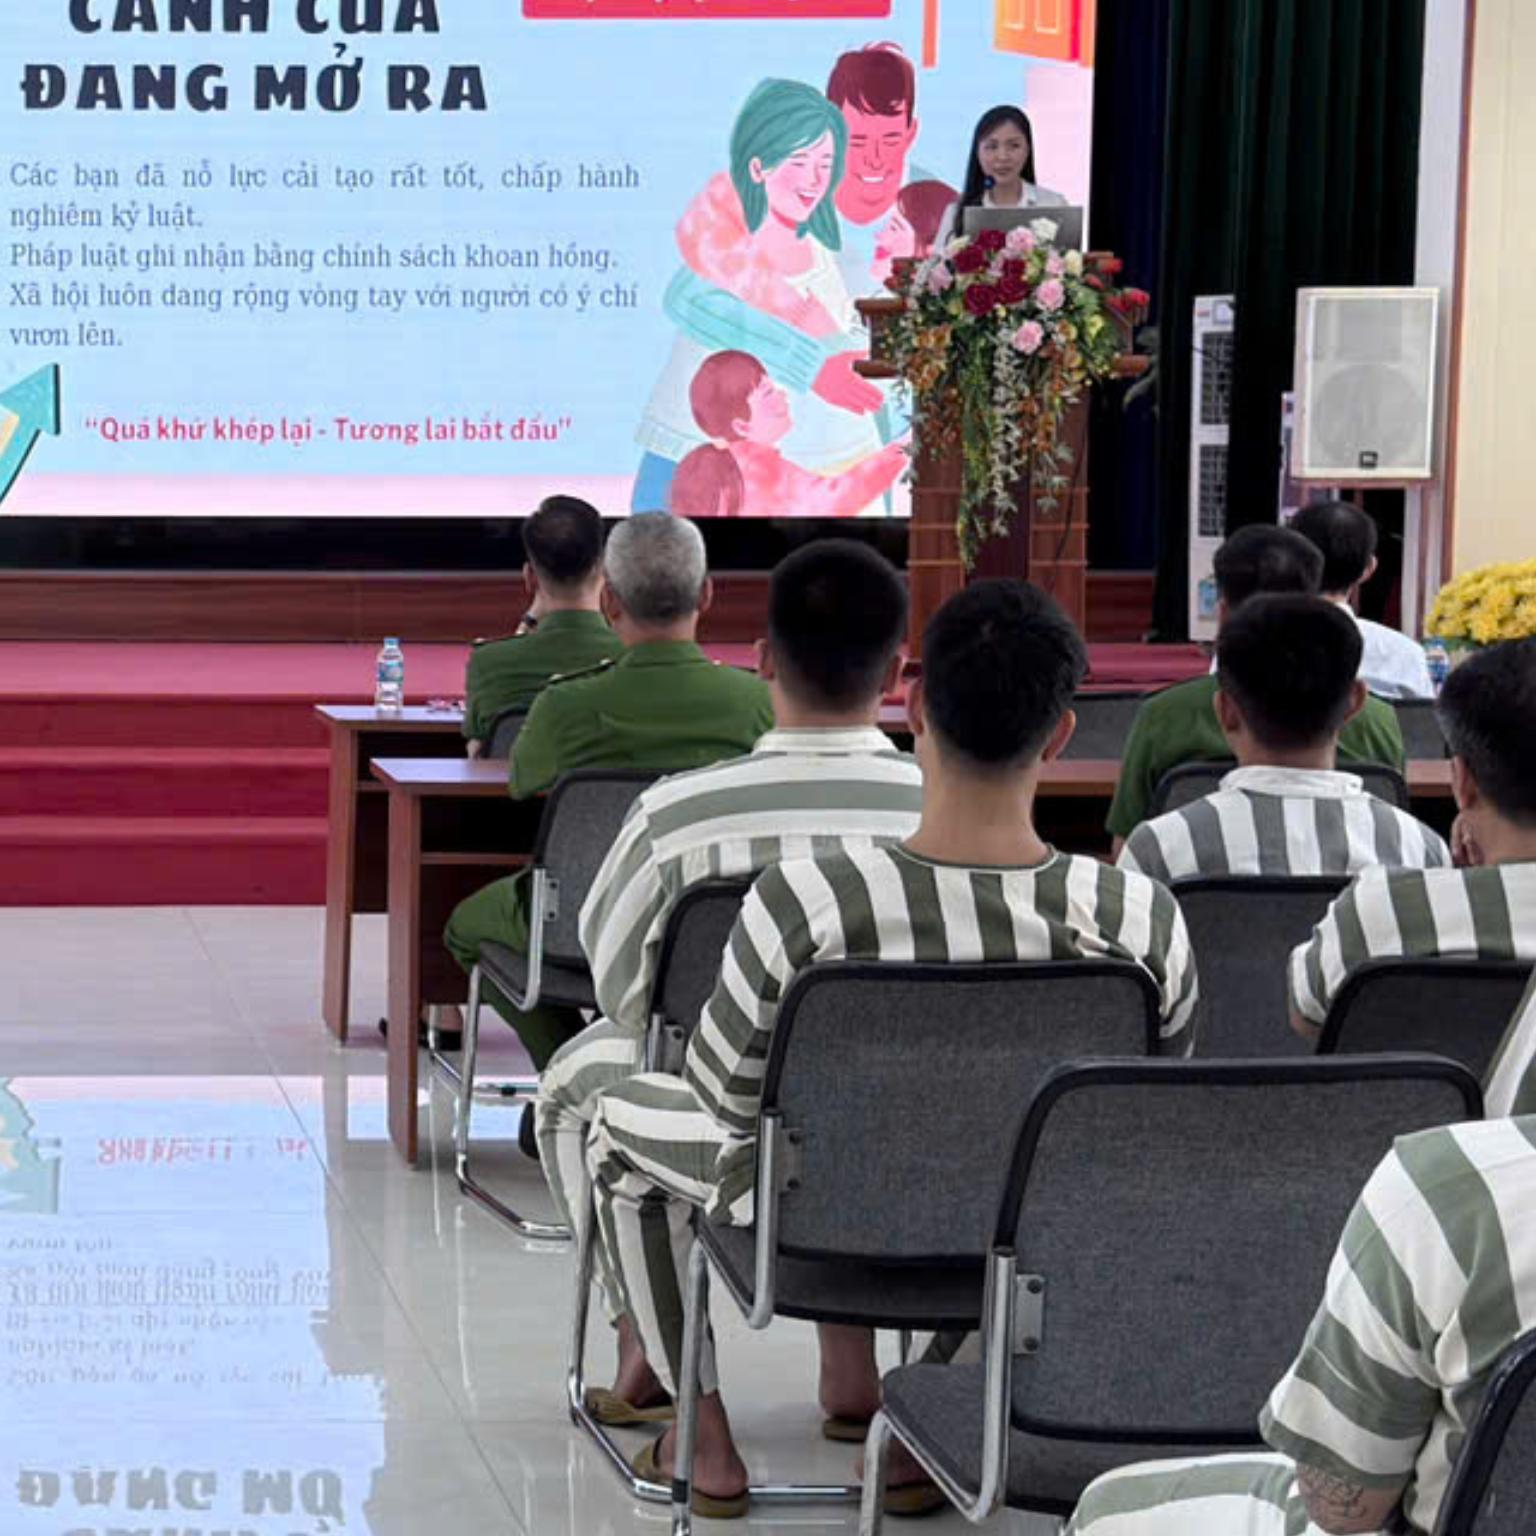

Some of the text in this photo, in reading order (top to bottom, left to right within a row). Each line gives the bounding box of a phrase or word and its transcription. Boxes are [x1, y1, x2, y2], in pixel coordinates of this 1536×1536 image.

[20, 43, 487, 112] ĐANG MỞ RA
[10, 159, 640, 192] Các bạn đã nỗ lực cải tạo rất tốt, chấp hành
[10, 202, 102, 231] nghiêm
[148, 202, 203, 231] luật.
[10, 242, 73, 271] Pháp
[81, 242, 128, 272] luật
[136, 244, 176, 272] ghi
[184, 242, 245, 272] nhận
[323, 242, 391, 267] chính
[399, 242, 455, 267] sách
[465, 243, 539, 267] khoan
[10, 282, 637, 313] Xã hội luôn dang rộng vòng tay với người có ý chí
[10, 323, 123, 346] vươn lên.
[157, 417, 206, 440] khứ
[214, 417, 274, 448] khép
[282, 417, 311, 446] lại
[335, 418, 418, 444] Tương
[426, 417, 456, 440] lai
[463, 412, 503, 441] bắt
